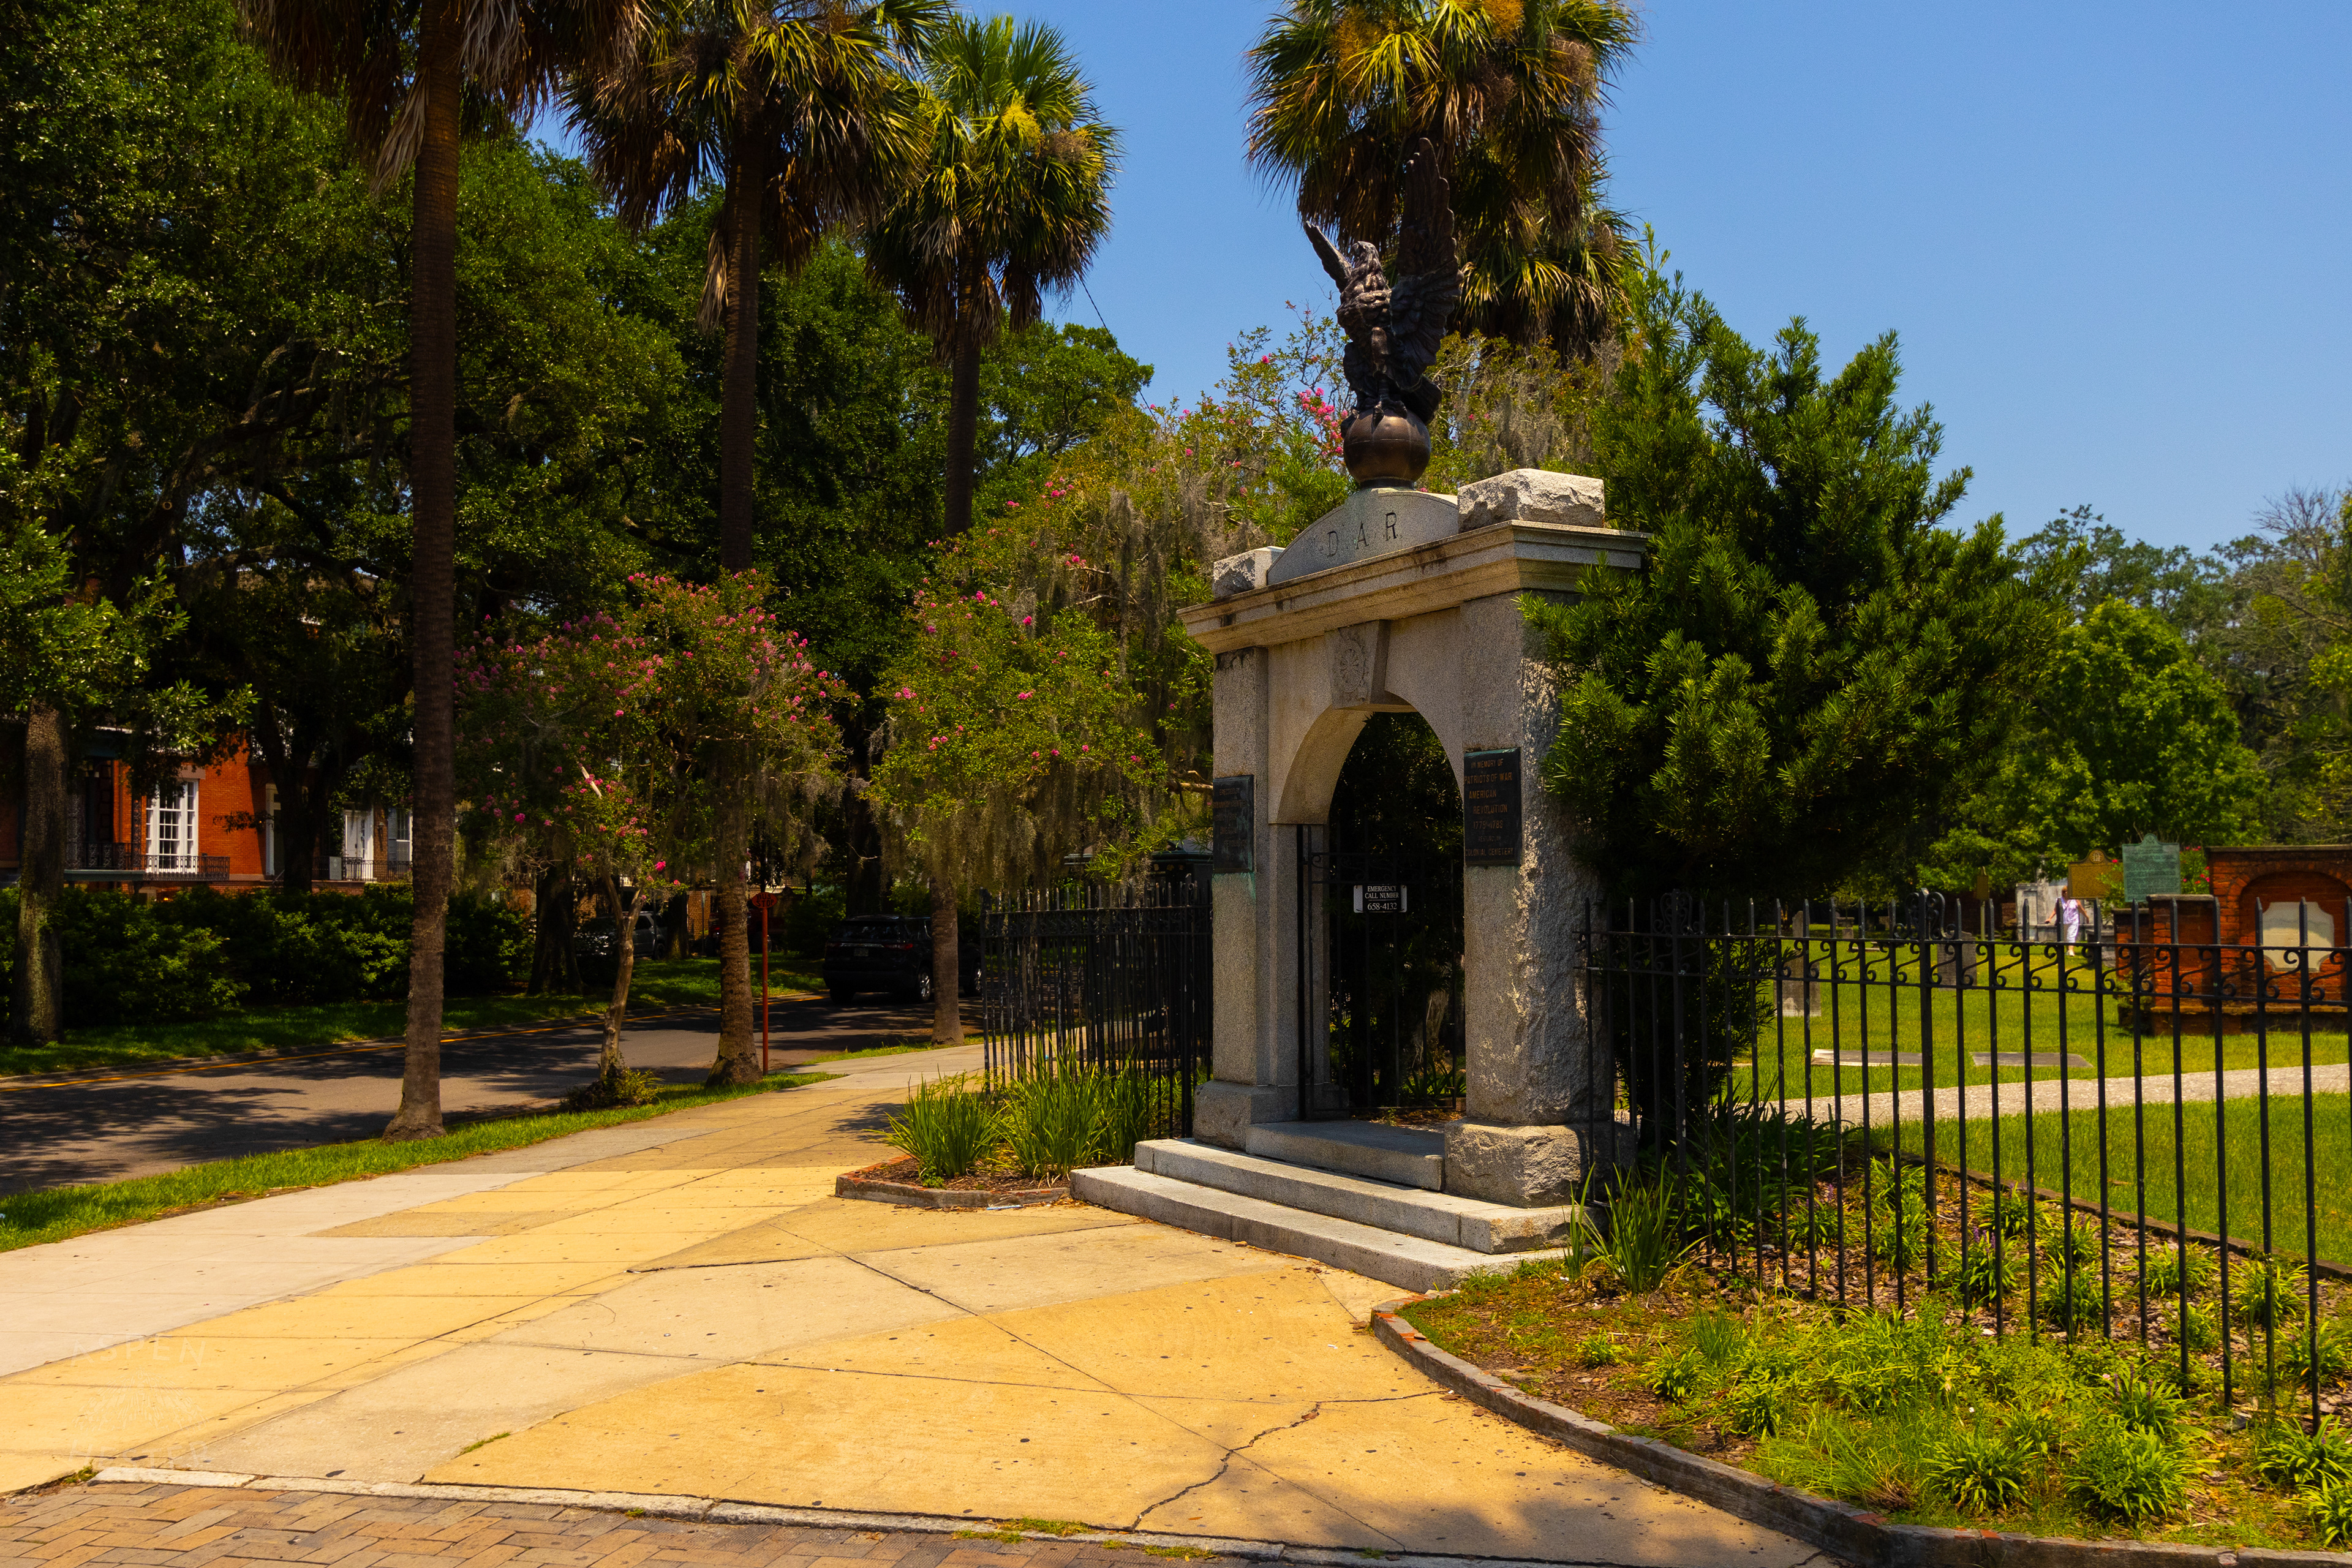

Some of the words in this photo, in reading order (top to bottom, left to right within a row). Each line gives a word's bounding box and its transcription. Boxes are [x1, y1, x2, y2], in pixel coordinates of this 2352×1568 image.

[1464, 775, 1490, 784] PATRIOTS
[1490, 773, 1498, 783] OF
[1499, 772, 1512, 781] WAR
[1469, 790, 1496, 799] AMERICAN
[1473, 805, 1507, 814] REVOLUTION
[1488, 847, 1513, 856] CEMETERY
